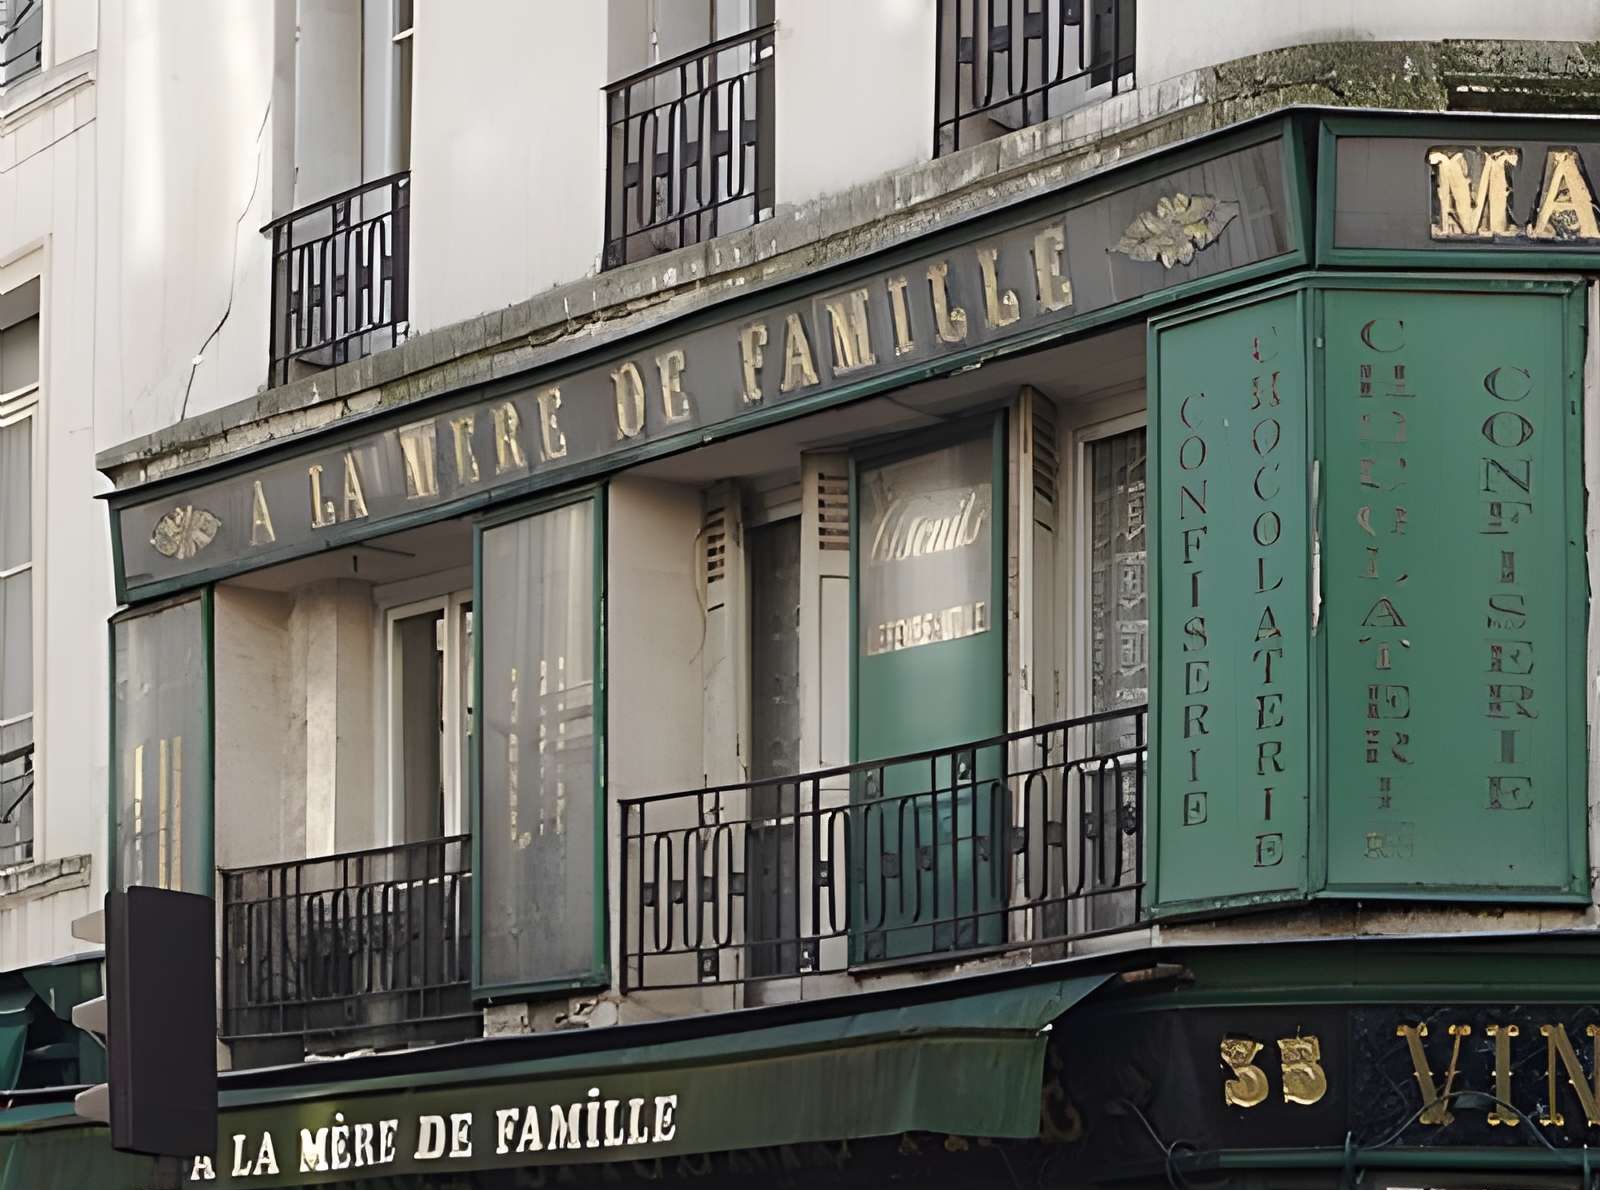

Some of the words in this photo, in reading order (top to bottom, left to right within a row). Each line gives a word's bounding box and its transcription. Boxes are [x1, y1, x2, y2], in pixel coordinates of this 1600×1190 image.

[248, 480, 276, 546] A
[308, 450, 370, 529] LA
[610, 348, 693, 440] DE
[738, 222, 1075, 404] FAMILLE
[1179, 393, 1211, 828] CONFISERIE
[231, 1131, 280, 1177] LA
[413, 1112, 473, 1160] DE
